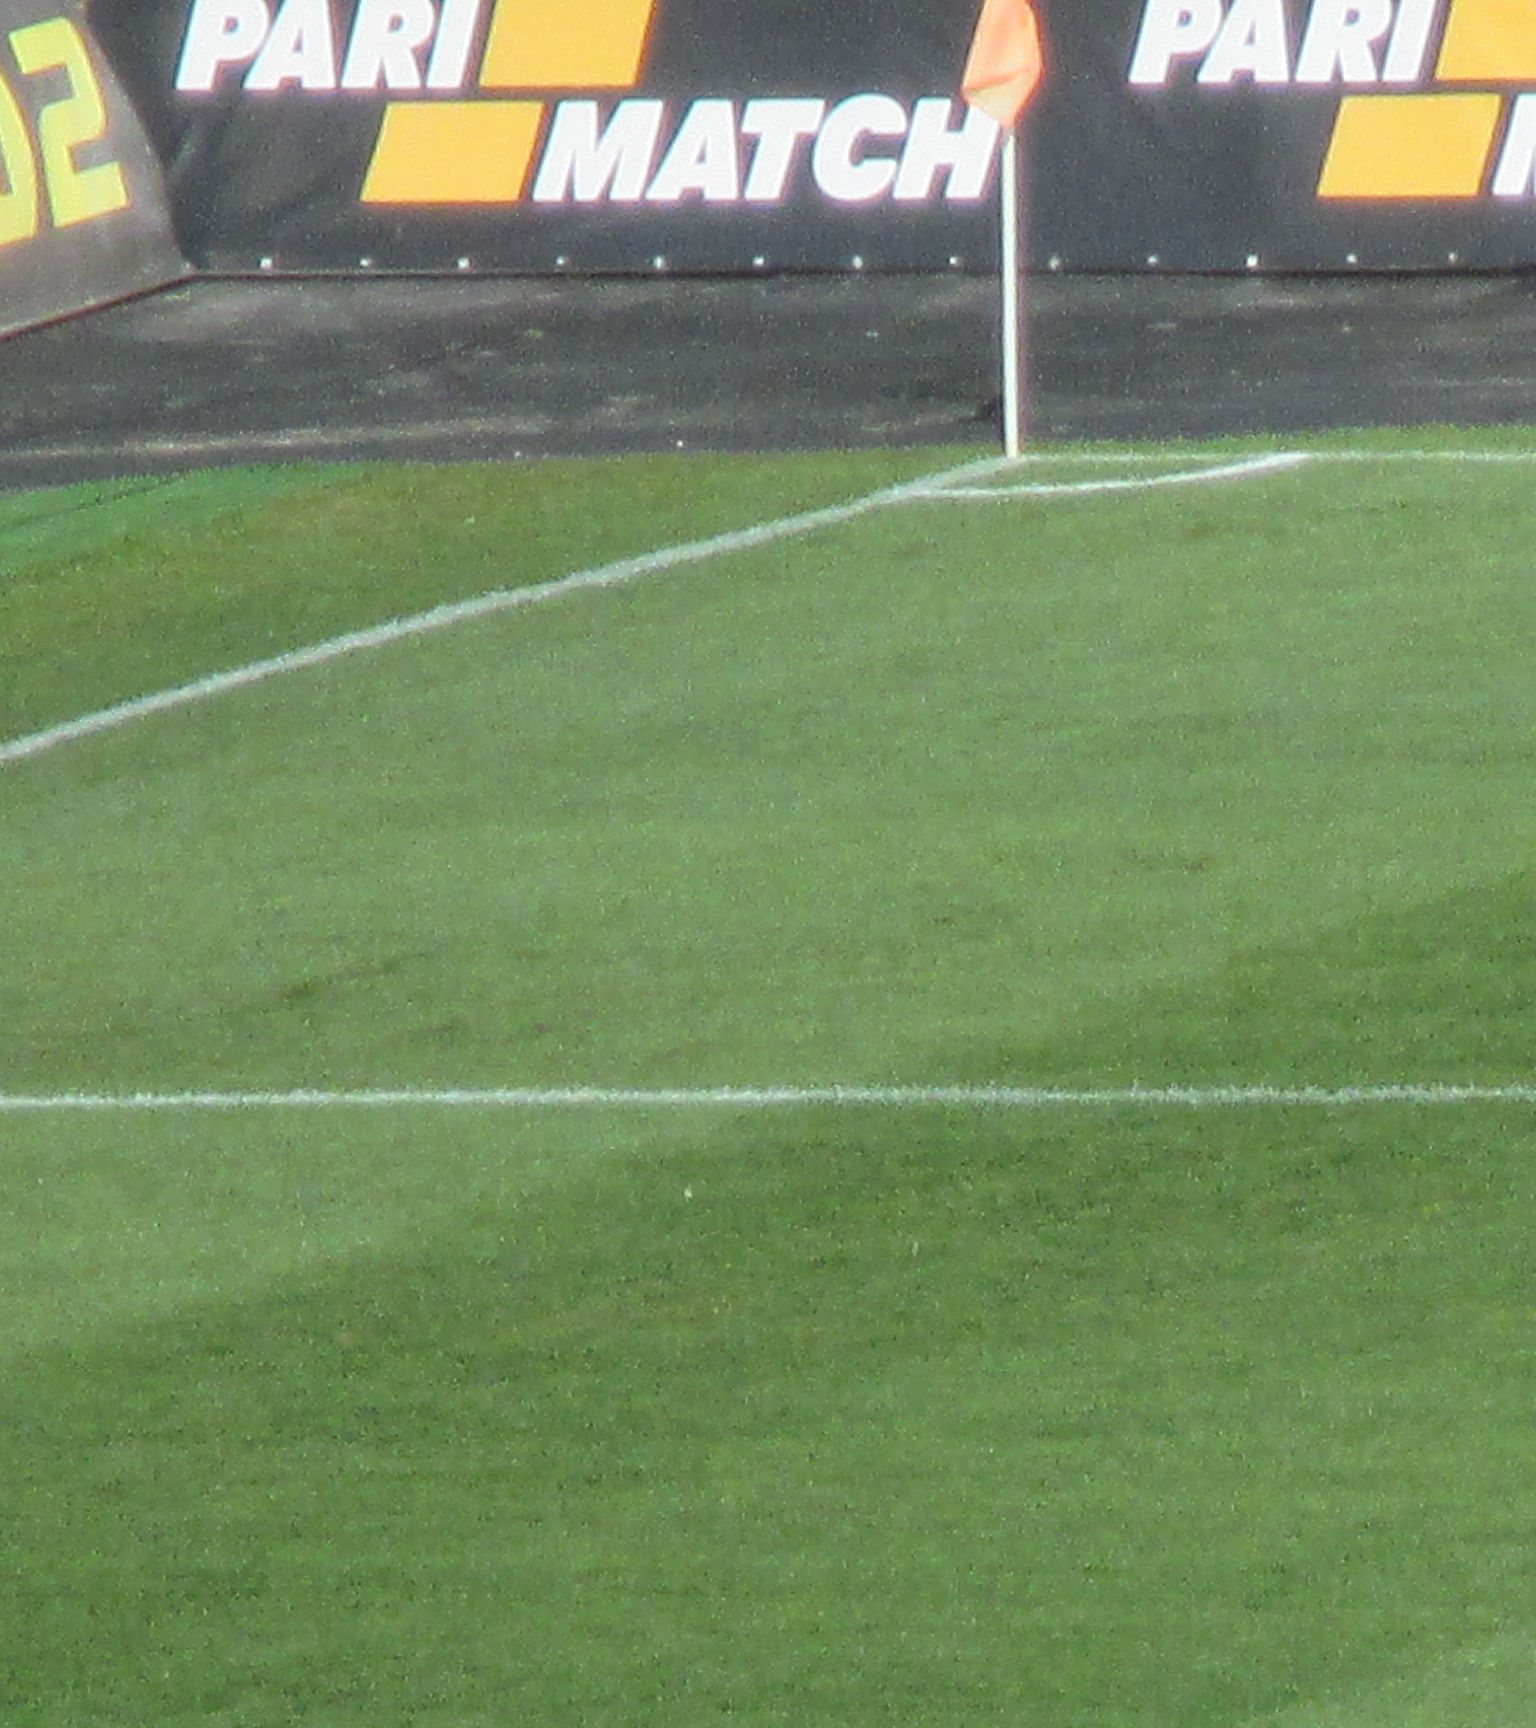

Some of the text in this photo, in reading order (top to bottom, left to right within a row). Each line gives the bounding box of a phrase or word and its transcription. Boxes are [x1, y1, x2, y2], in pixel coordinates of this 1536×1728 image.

[176, 0, 481, 90] PARI
[1129, 0, 1437, 85] PARI
[532, 95, 1006, 202] MATCH
